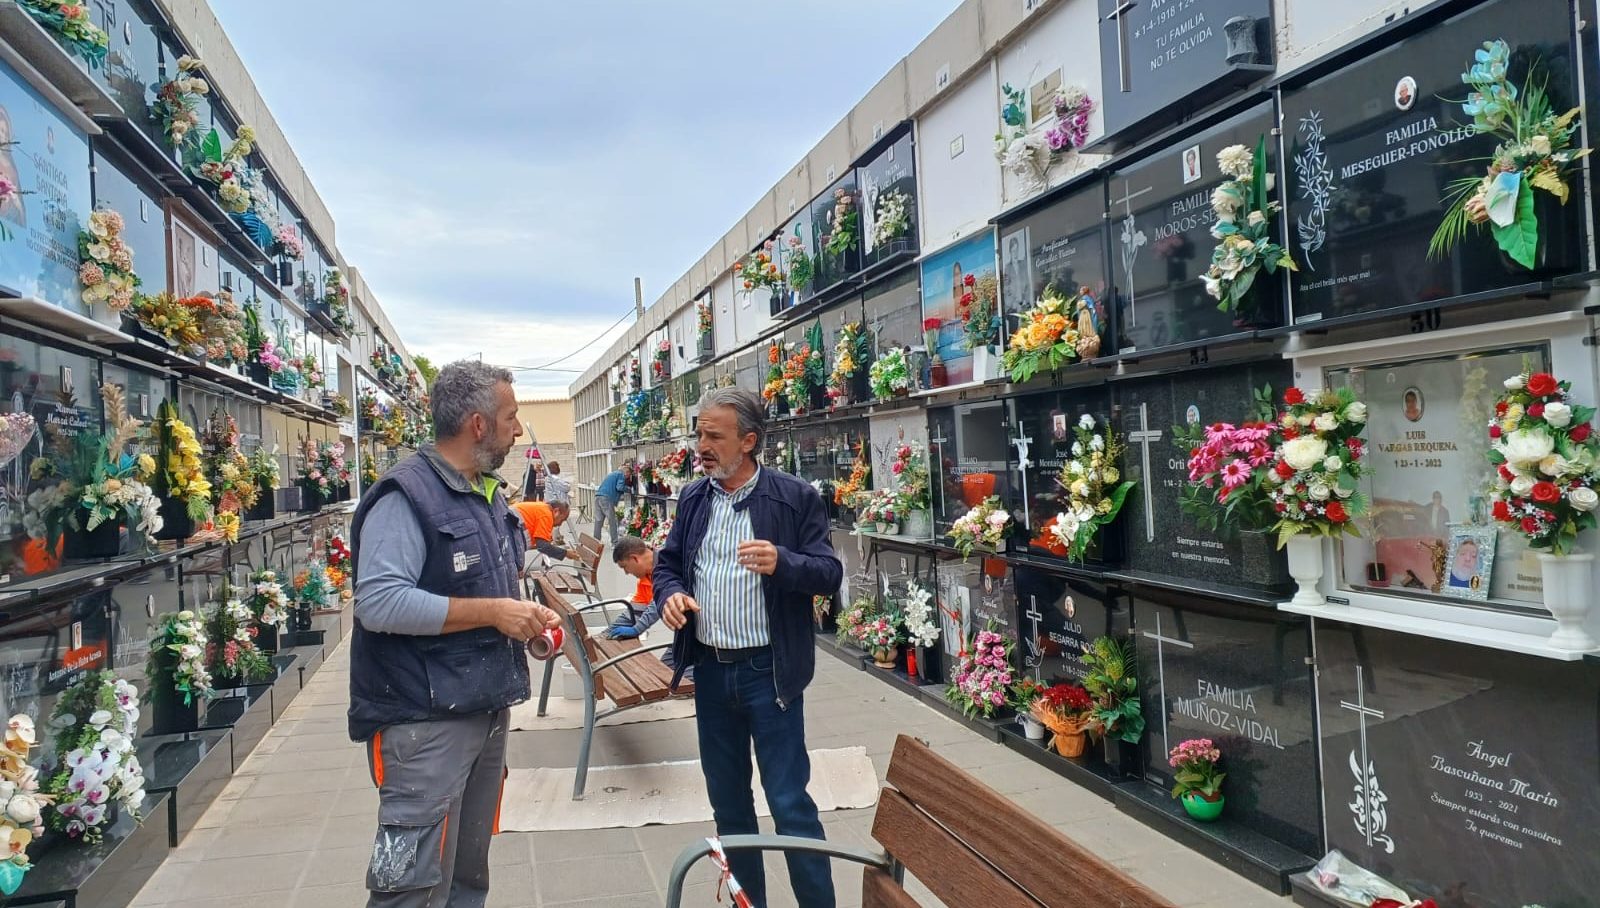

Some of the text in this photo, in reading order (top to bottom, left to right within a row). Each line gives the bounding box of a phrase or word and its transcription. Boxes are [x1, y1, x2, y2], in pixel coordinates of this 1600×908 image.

[1156, 12, 1205, 49] TU FAMILIA
[1151, 26, 1212, 71] NO TE OLVIDA
[1386, 117, 1437, 145] FAMILIA
[1341, 124, 1476, 180] MESEGUER-FONOLLO
[1172, 189, 1211, 216] FAMILI
[1155, 208, 1217, 241] MOROS-SE
[1378, 441, 1458, 453] VARGAS REQUENA
[1406, 430, 1426, 440] LUIS
[1176, 536, 1200, 547] Siempre
[1180, 552, 1202, 561] nuestra
[1049, 631, 1080, 649] SEGARRA
[1064, 621, 1082, 634] JULIO
[1198, 679, 1256, 714] FAMILIA
[1178, 696, 1285, 750] MUÑOZ-VIDAL
[1467, 739, 1512, 768] Ángel
[1430, 755, 1558, 807] Bascuñana Marín
[1430, 791, 1563, 846] Siempre estarás con nosotros
[1498, 800, 1519, 814] 2021
[1465, 819, 1523, 849] Te queremos
